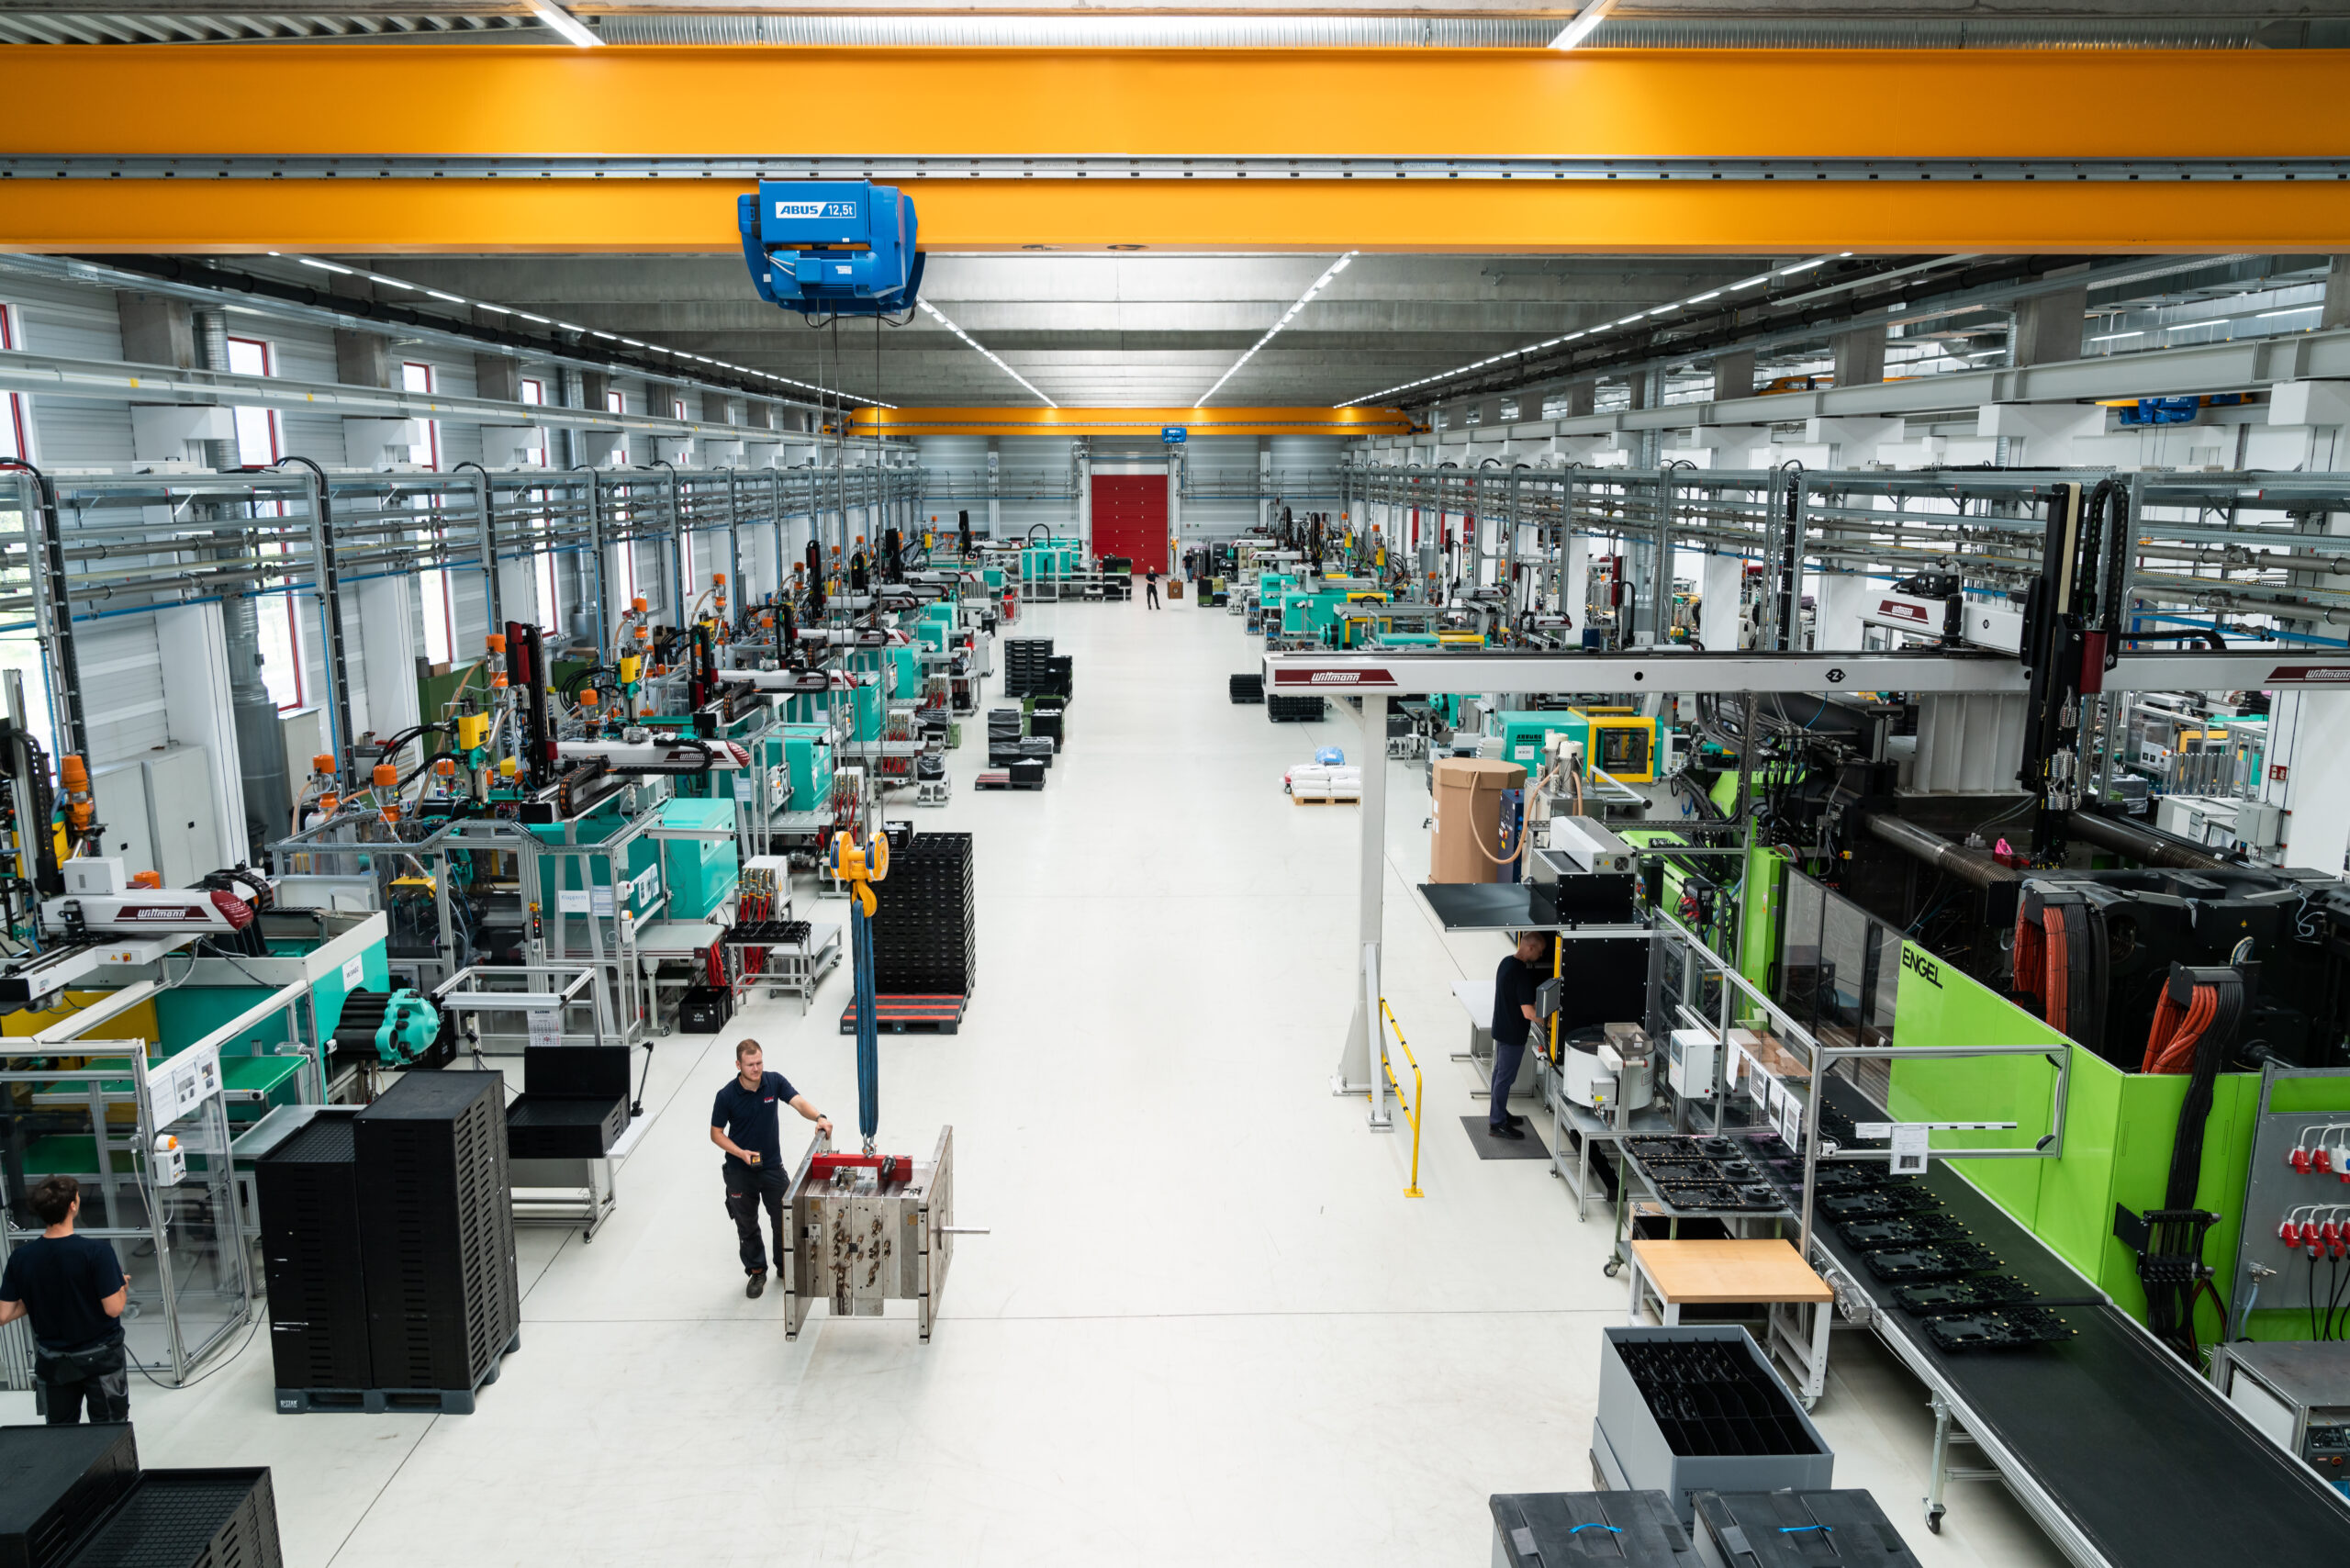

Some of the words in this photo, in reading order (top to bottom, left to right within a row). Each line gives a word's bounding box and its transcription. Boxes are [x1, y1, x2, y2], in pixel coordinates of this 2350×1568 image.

[780, 205, 819, 215] ABUS
[828, 204, 854, 217] 12,5t
[1311, 671, 1361, 682] Wittmann
[137, 908, 186, 918] Wittmann
[1902, 946, 1943, 990] ENGEL
